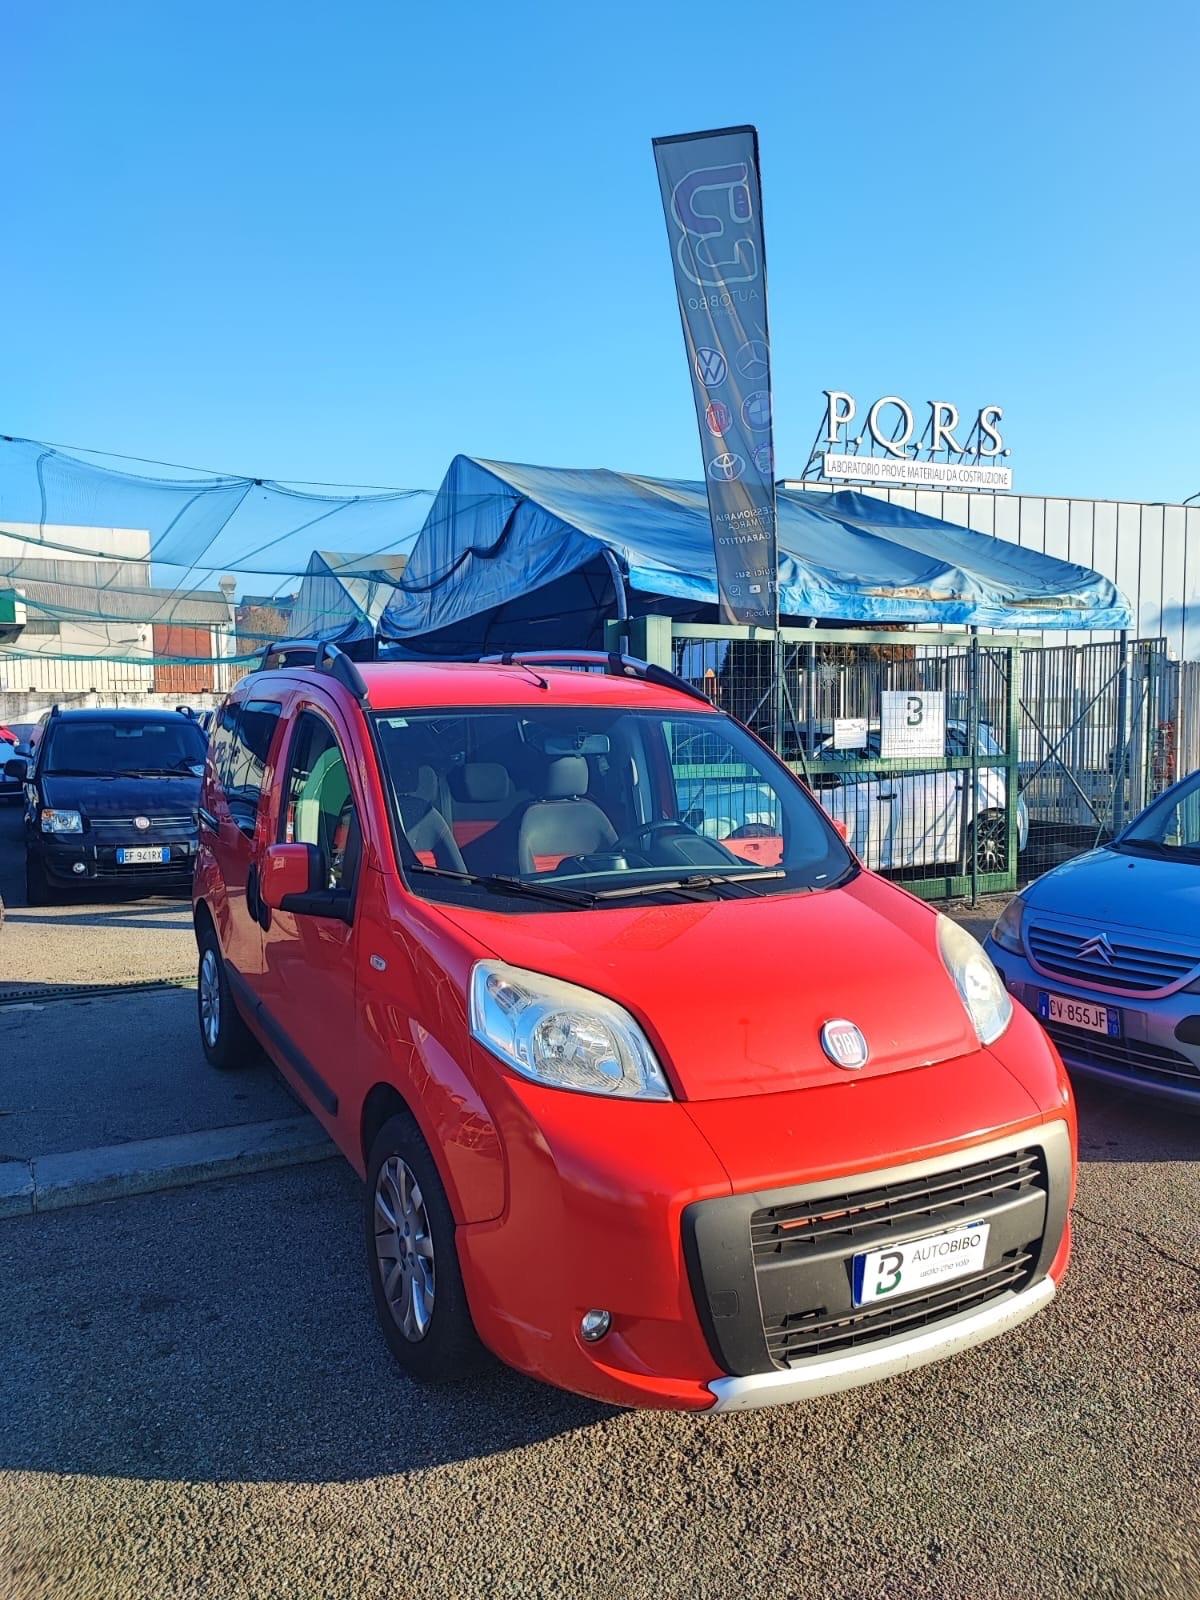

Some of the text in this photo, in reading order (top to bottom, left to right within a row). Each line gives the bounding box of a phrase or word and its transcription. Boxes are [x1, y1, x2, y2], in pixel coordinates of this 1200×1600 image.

[823, 390, 1011, 458] P.Q.R.S.
[827, 460, 1009, 485] LABORATORIO PROVE MATERIALI DA COSTRUZIONE
[124, 851, 135, 861] EF
[1049, 999, 1106, 1029] CV 855JF
[911, 1234, 981, 1264] AUTOBIBO
